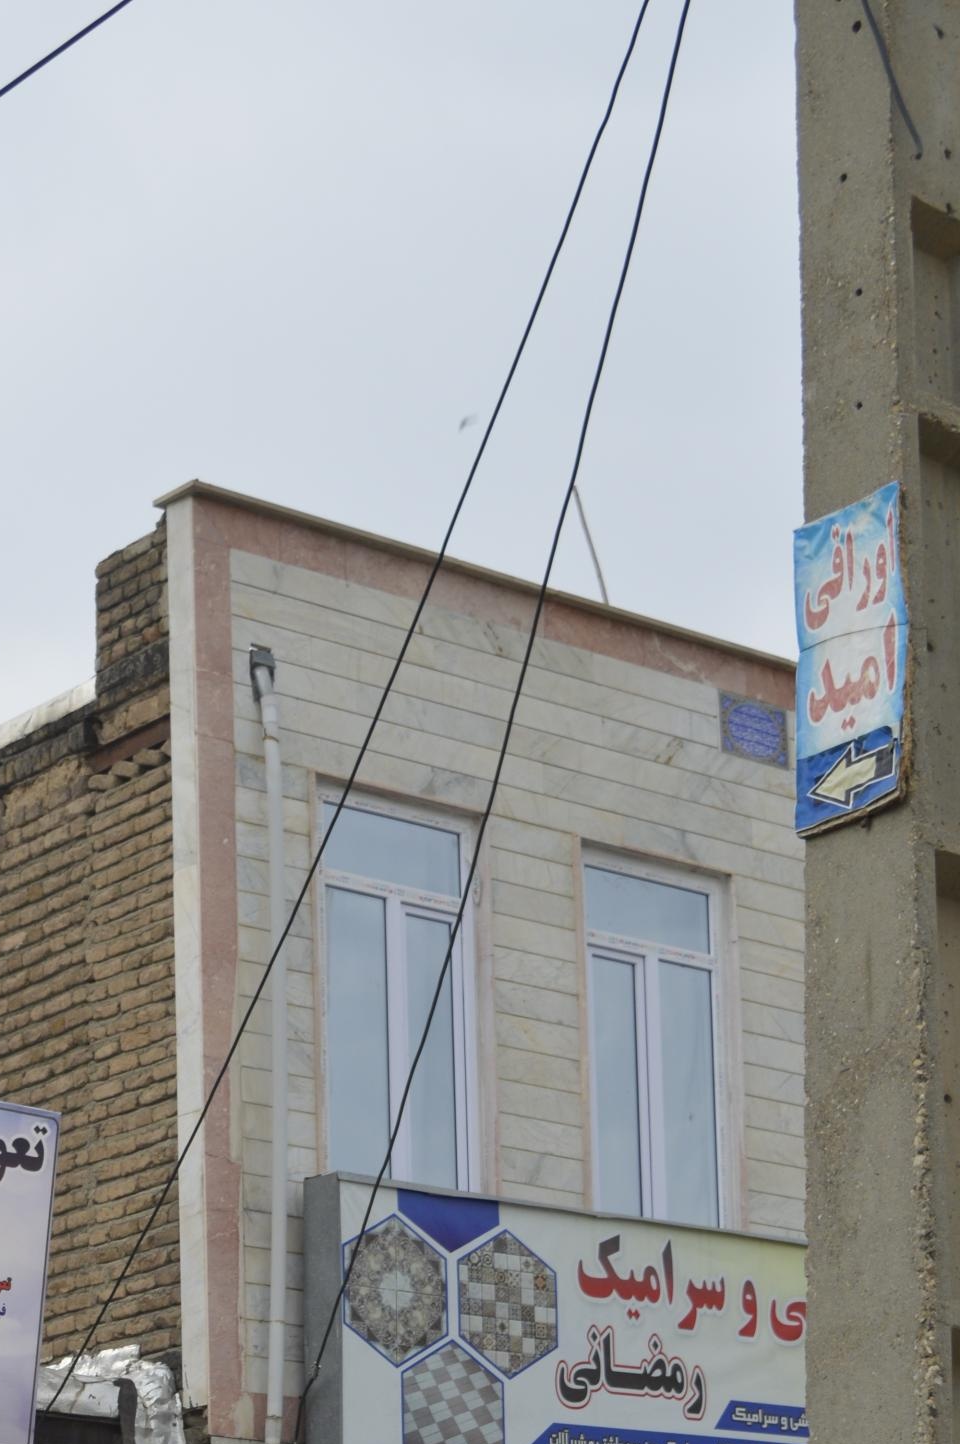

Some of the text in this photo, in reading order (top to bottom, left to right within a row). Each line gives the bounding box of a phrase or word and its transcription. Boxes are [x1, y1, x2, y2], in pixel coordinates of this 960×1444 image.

[807, 610, 898, 730] امید
[578, 1234, 726, 1331] سرامیک
[738, 1280, 757, 1337] و
[556, 1324, 707, 1421] رمضانی
[732, 1407, 778, 1428] سرامیک
